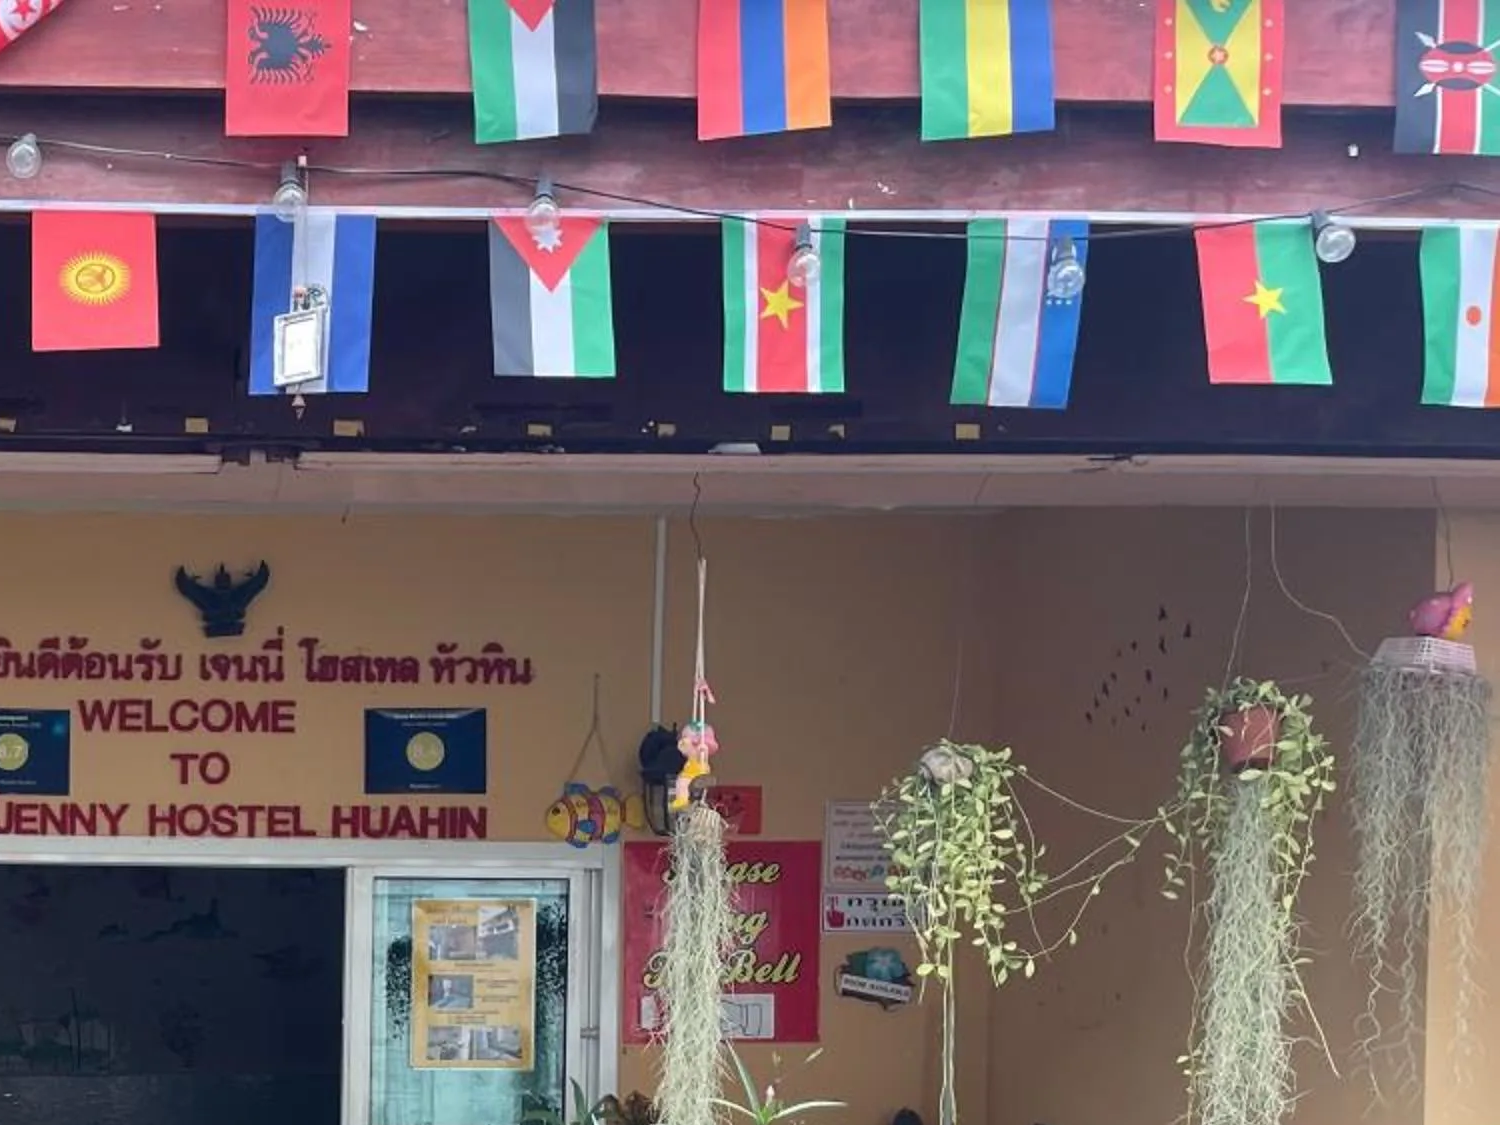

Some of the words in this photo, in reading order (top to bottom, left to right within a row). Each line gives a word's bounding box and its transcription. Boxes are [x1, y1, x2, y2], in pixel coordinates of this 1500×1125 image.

[200, 626, 284, 684] เจนนี่
[78, 698, 297, 733] WELCOME
[169, 751, 231, 785] TO
[150, 804, 317, 838] HOSTEL
[332, 805, 488, 839] HUAHIN
[718, 949, 801, 985] Bell
